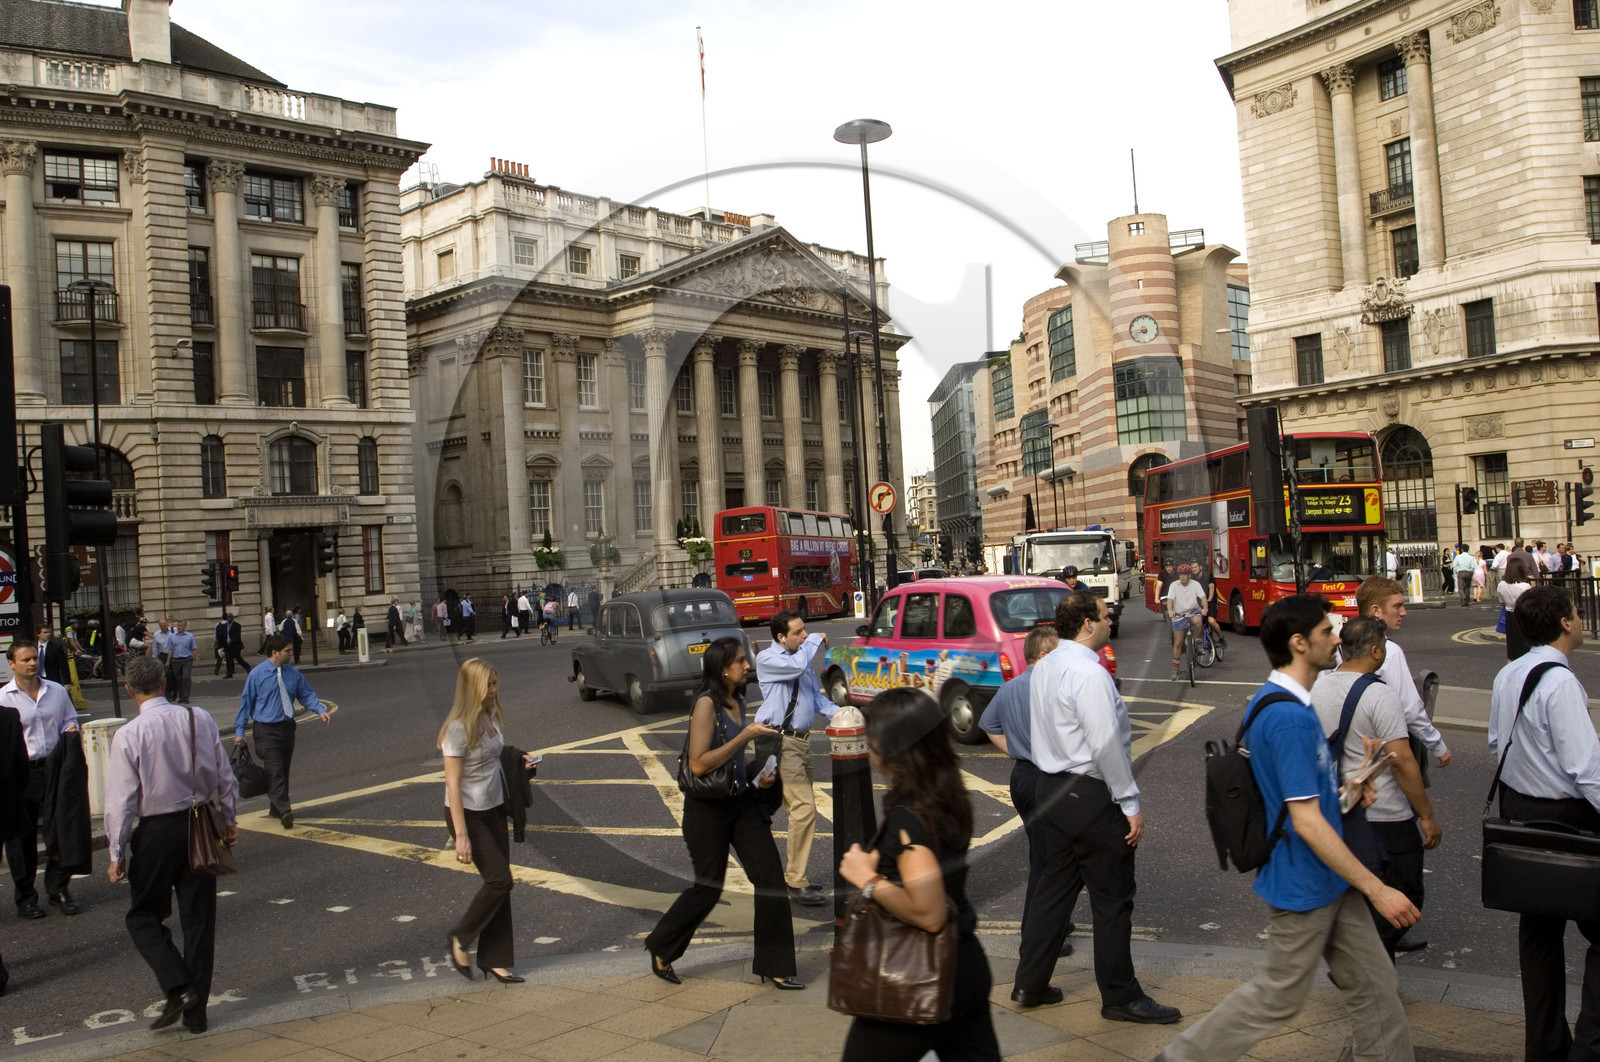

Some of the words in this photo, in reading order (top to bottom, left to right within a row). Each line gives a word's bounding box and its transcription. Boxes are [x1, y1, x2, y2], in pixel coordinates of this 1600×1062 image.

[1338, 495, 1352, 506] 23
[1305, 508, 1322, 516] Liverpool
[742, 550, 751, 558] 23
[850, 654, 904, 689] Sandals
[293, 952, 458, 993] RIGH
